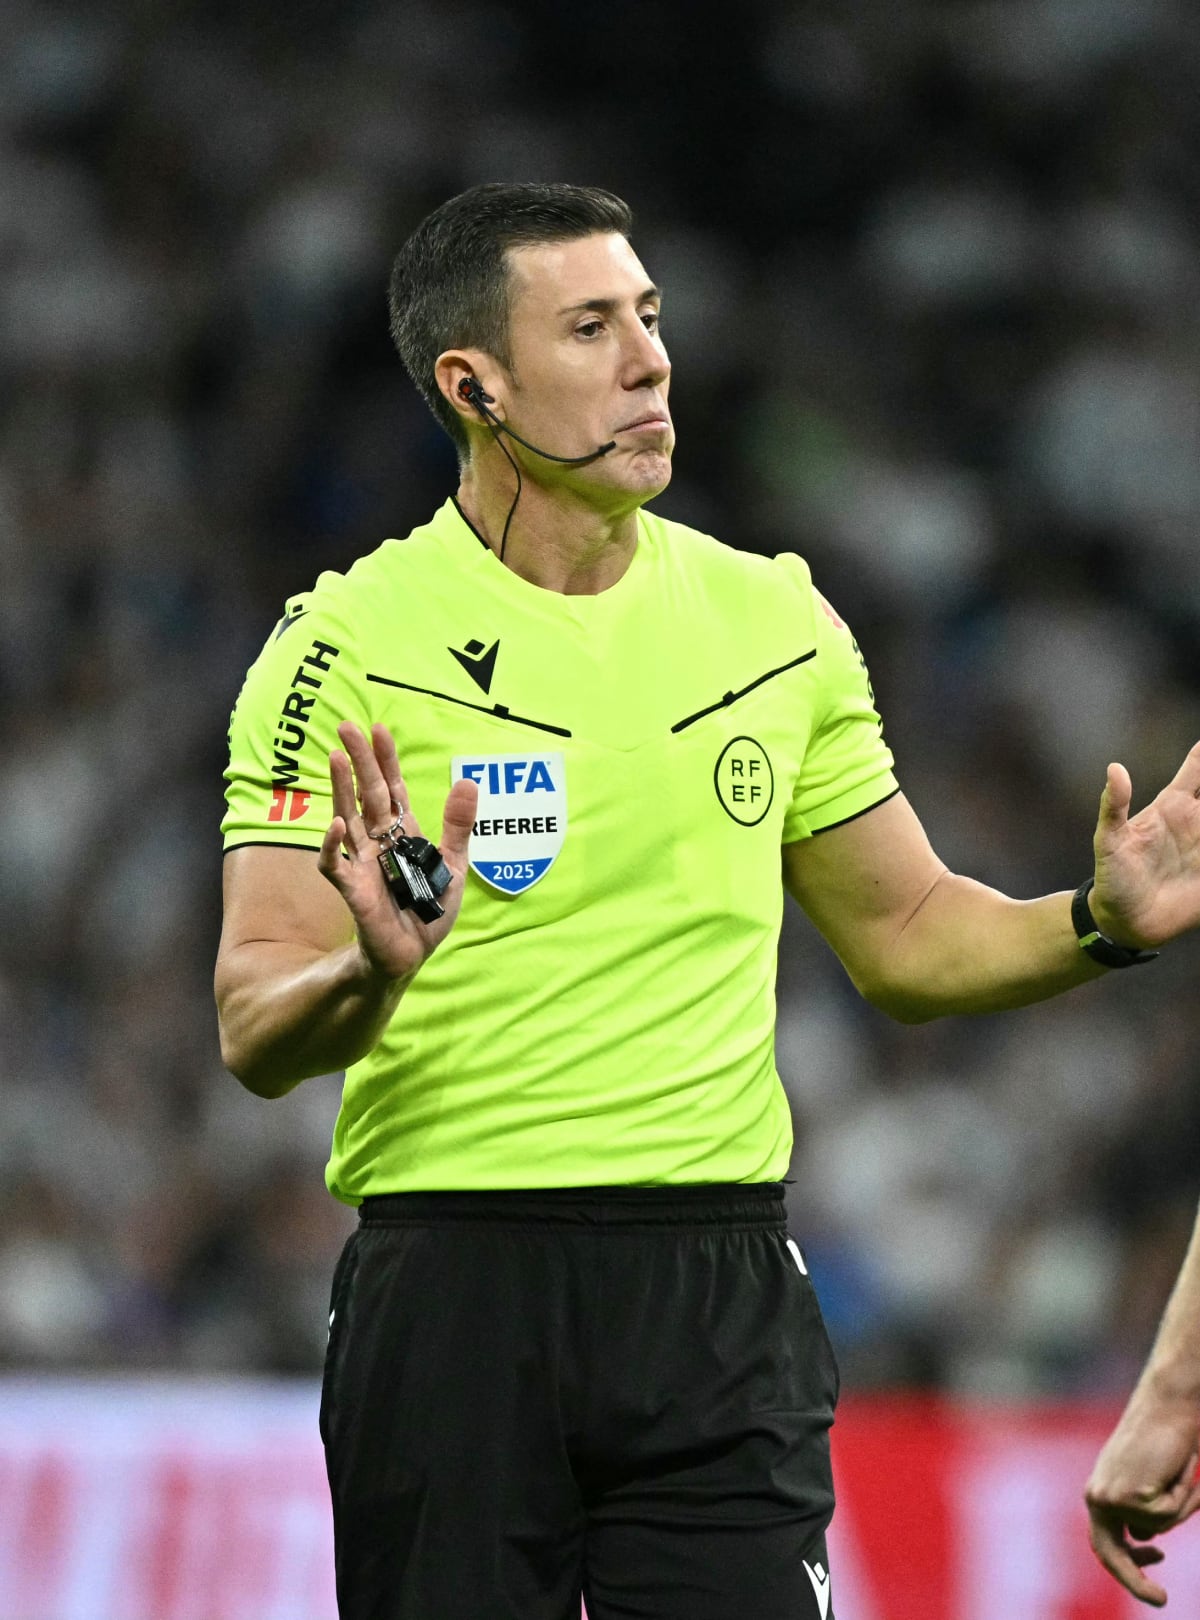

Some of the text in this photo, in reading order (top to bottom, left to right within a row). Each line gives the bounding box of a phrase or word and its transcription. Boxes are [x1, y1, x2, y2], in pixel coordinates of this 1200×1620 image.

[271, 640, 340, 786] WÜRTH
[462, 761, 556, 795] FIFA
[493, 864, 534, 880] 2025
